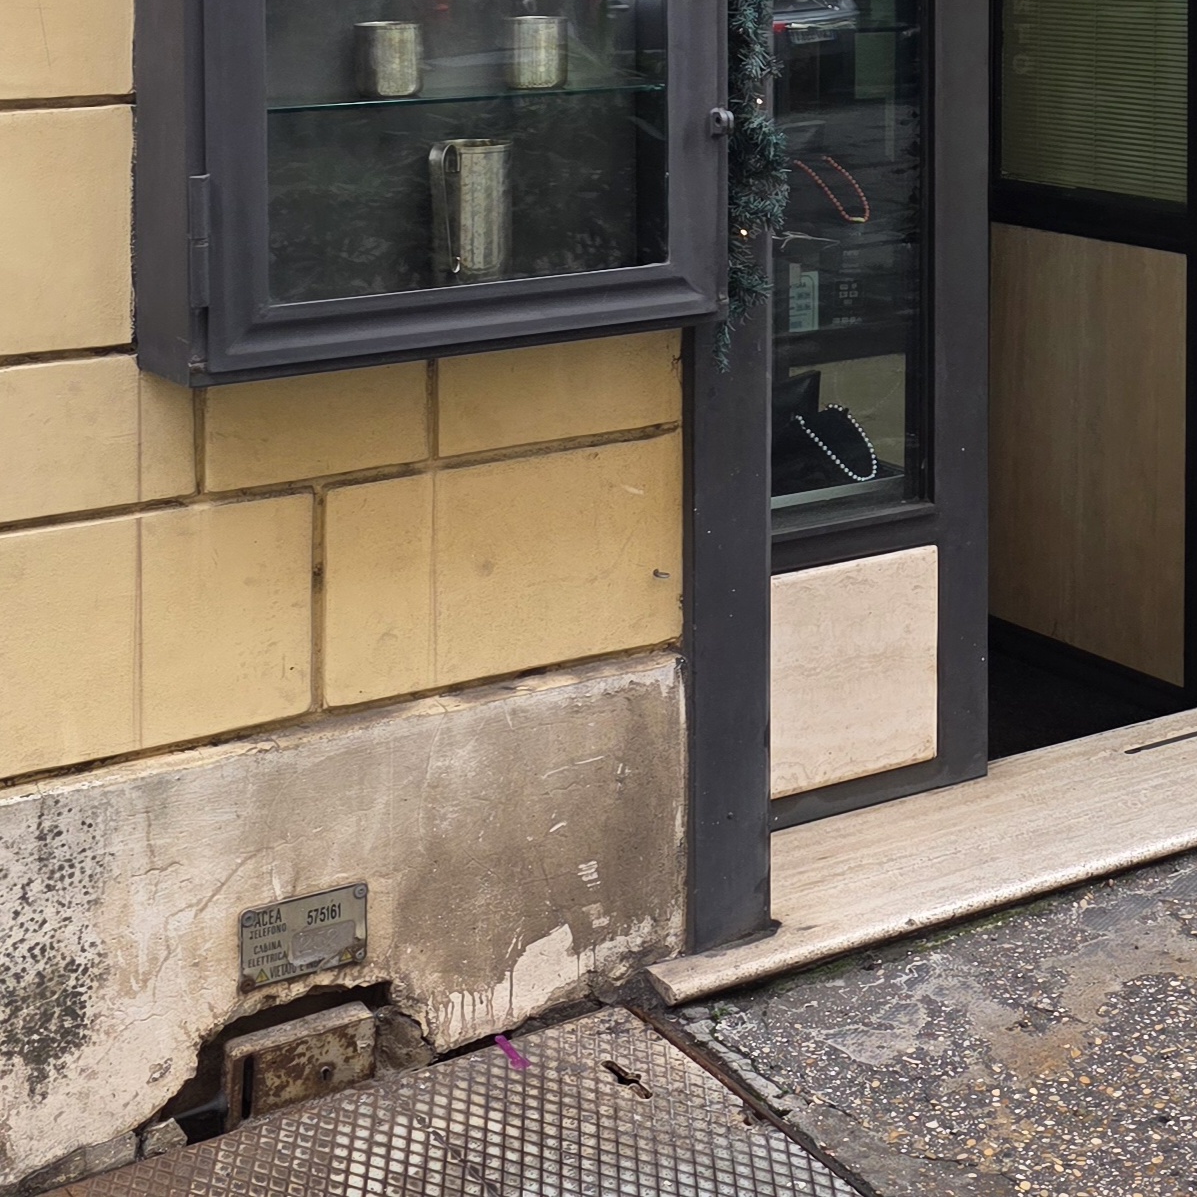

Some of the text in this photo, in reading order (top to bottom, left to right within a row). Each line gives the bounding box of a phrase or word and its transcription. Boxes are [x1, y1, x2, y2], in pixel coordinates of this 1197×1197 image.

[254, 902, 342, 928] ACEA 575161
[249, 922, 287, 940] TELEFONO
[248, 950, 289, 969] ELETTRICA
